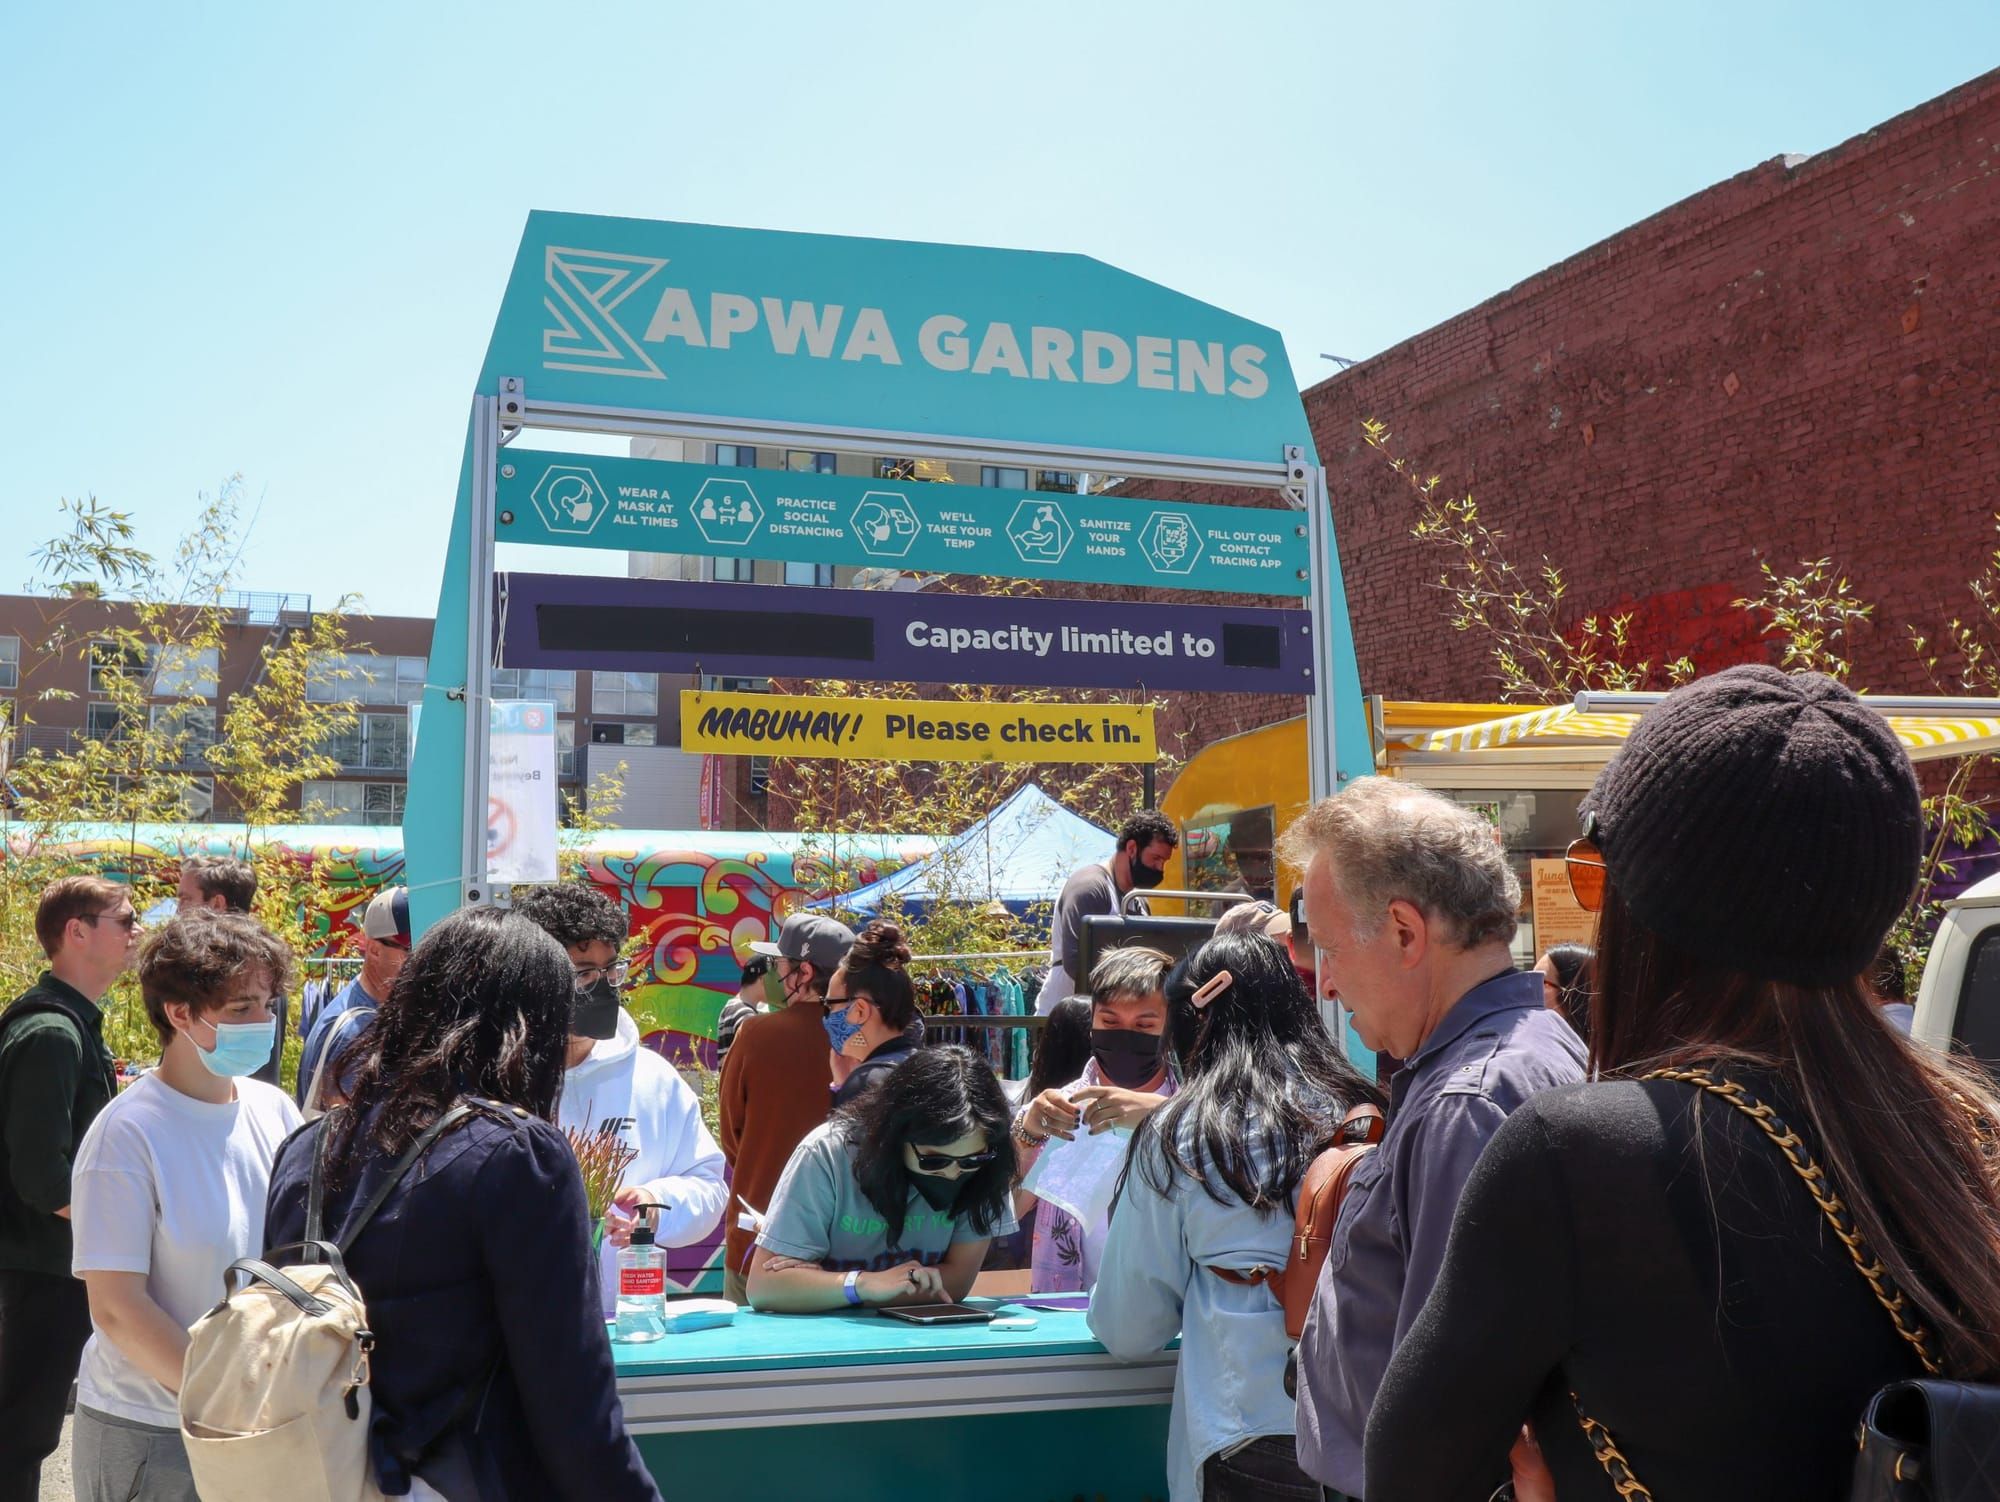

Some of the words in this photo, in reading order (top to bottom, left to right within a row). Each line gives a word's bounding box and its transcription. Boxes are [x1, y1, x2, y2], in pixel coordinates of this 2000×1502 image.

[917, 313, 1269, 399] GARDENS
[618, 486, 658, 500] WEAR
[660, 489, 671, 501] A
[723, 495, 732, 506] 6
[617, 500, 655, 513] MASK
[657, 503, 674, 514] AT
[776, 496, 837, 511] PRACTICE
[612, 513, 638, 526] ALL
[640, 515, 679, 528] TIMES
[719, 514, 737, 526] FT
[783, 511, 829, 525] SOCIAL
[939, 511, 976, 523] WE'LL
[769, 523, 844, 539] DISTANCING
[926, 523, 958, 535] TAKE
[959, 525, 993, 537] YOUR
[1079, 518, 1132, 532] SANITIZE
[943, 537, 976, 549] TEMP
[1088, 532, 1121, 544] YOUR
[1207, 529, 1231, 542] FILL
[1233, 531, 1258, 543] OUT
[1258, 533, 1282, 544] OUR
[1086, 544, 1127, 557] HANDS
[1219, 544, 1271, 556] CONTACT
[1209, 556, 1258, 568] TRACING
[1259, 558, 1282, 569] APP
[905, 620, 1054, 658] Capacity
[1060, 625, 1174, 657] limited
[1181, 632, 1216, 658] to
[697, 706, 864, 746] MABUHAY!
[885, 714, 991, 742] Please
[999, 717, 1091, 743] check
[1102, 719, 1141, 744] in.
